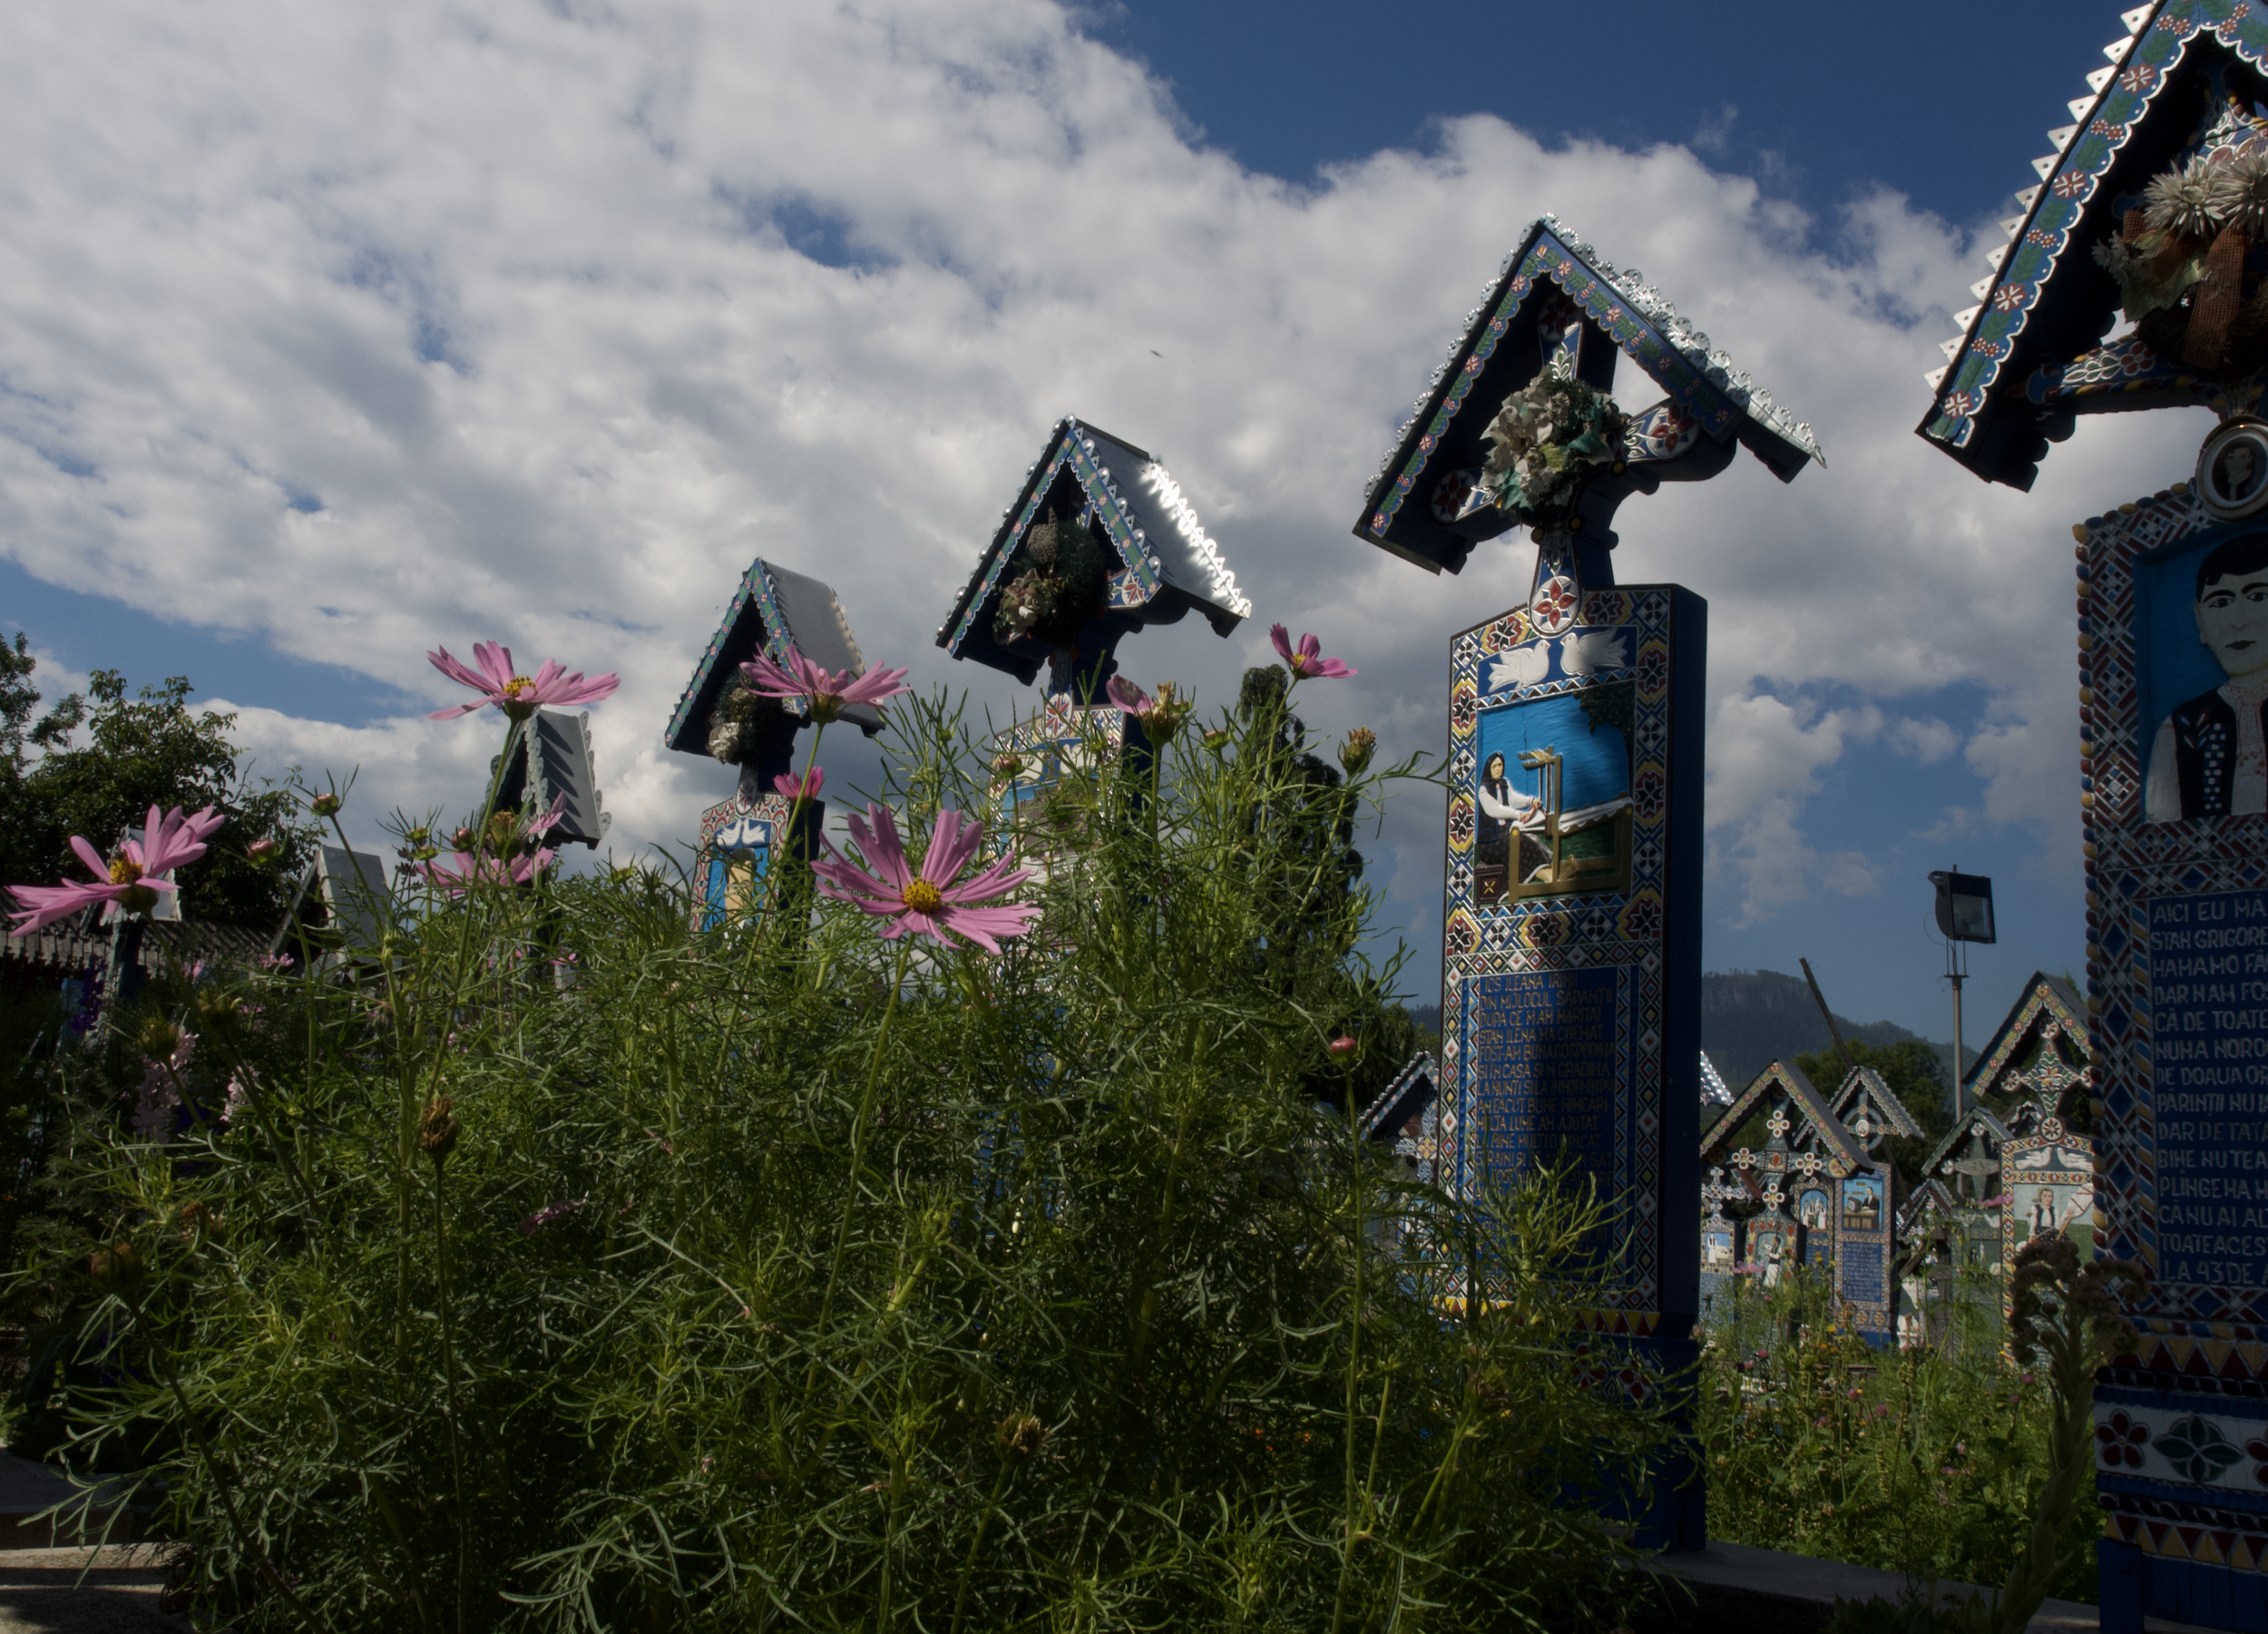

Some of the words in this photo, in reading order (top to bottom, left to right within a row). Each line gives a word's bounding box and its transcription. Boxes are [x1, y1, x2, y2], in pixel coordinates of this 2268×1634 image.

[2153, 903, 2189, 924] AICI
[2197, 900, 2226, 921] EU
[2150, 930, 2191, 951] STAN
[2244, 948, 2268, 974] FĂ
[1505, 974, 1544, 992] ILEANA
[1481, 995, 1497, 1012] DIN
[1501, 991, 1552, 1010] MIJLOCUL
[2155, 983, 2189, 1005] DAR
[1509, 1010, 1522, 1026] CE
[2183, 1010, 2206, 1032] DE
[2211, 1008, 2268, 1030] TOATE
[1480, 1029, 1503, 1044] STAN
[1506, 1027, 1537, 1043] ILENA
[1558, 1023, 1604, 1041] CHEMAT
[2155, 1039, 2209, 1061] NUMA
[2214, 1037, 2268, 1059] NORO
[2156, 1066, 2175, 1085] DE
[2180, 1066, 2243, 1085] DOAUA
[2229, 1092, 2255, 1112] NU
[1510, 1115, 1536, 1131] LUME
[1538, 1116, 1555, 1131] AM
[1558, 1114, 1599, 1131] AJUTAT
[2158, 1120, 2195, 1141] DAR
[2198, 1120, 2224, 1141] DE
[1476, 1133, 1489, 1149] L
[2158, 1149, 2196, 1169] BINE
[2201, 1150, 2228, 1169] NU
[2185, 1204, 2214, 1226] NU
[2216, 1206, 2237, 1227] AI
[2164, 1258, 2192, 1281] LA
[2196, 1260, 2224, 1284] 43
[2225, 1261, 2254, 1285] DE
